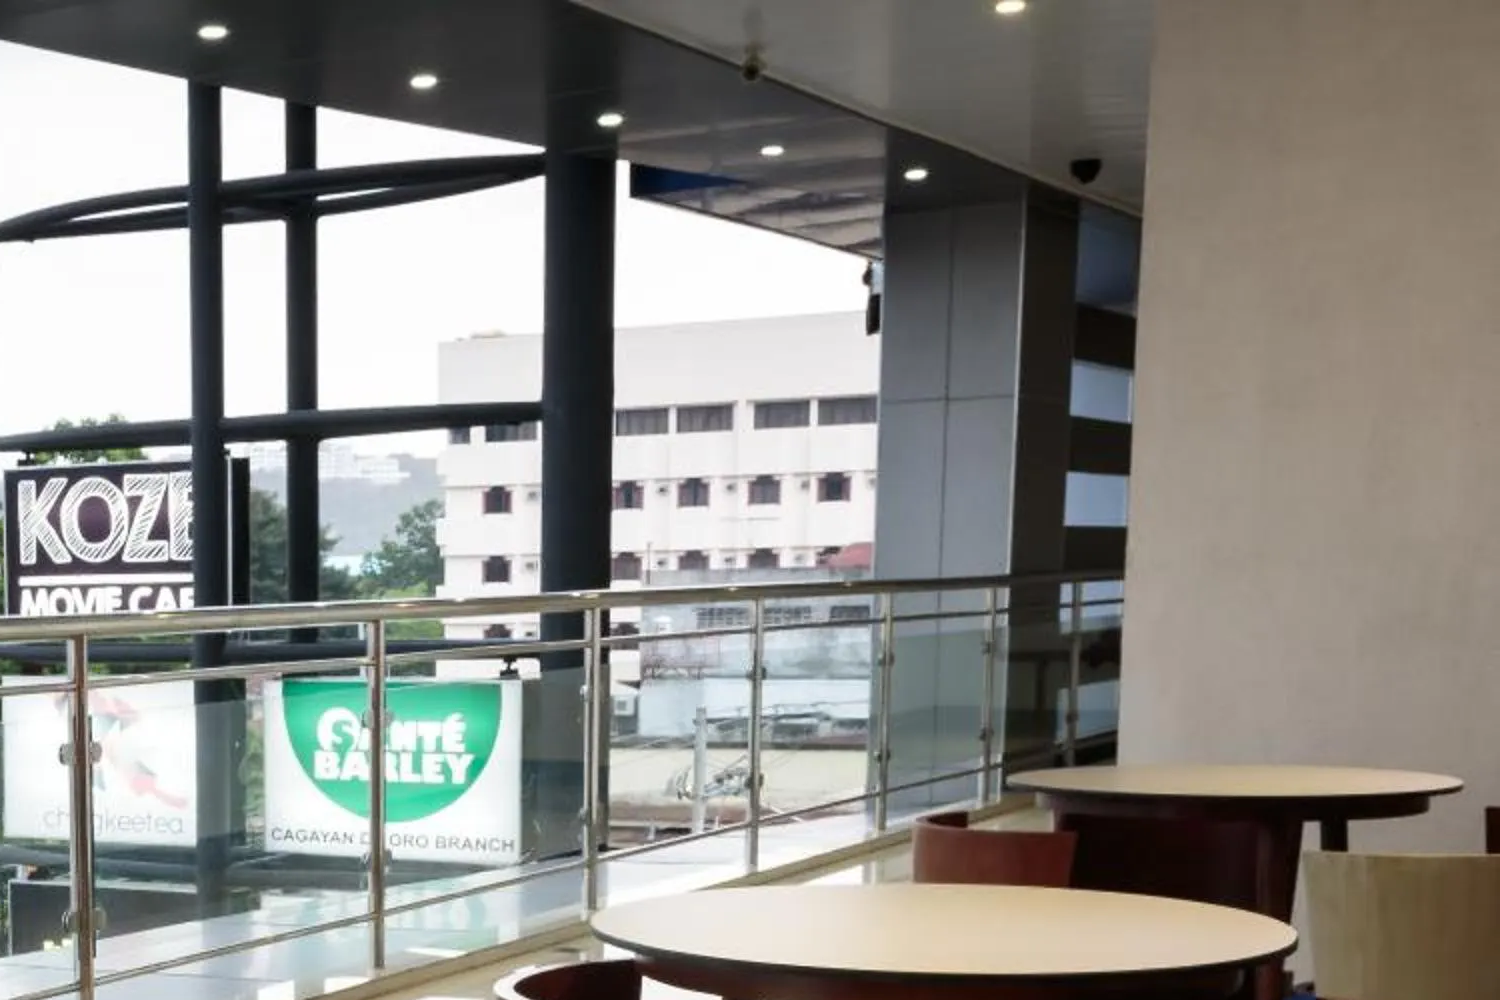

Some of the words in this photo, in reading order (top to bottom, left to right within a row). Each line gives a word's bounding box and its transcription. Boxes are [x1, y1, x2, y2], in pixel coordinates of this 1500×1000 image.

[21, 587, 122, 616] MOVIE
[129, 586, 194, 612] CAF
[271, 827, 354, 844] CAGAYAN
[389, 833, 429, 849] ORO
[435, 835, 515, 853] BRANCH
